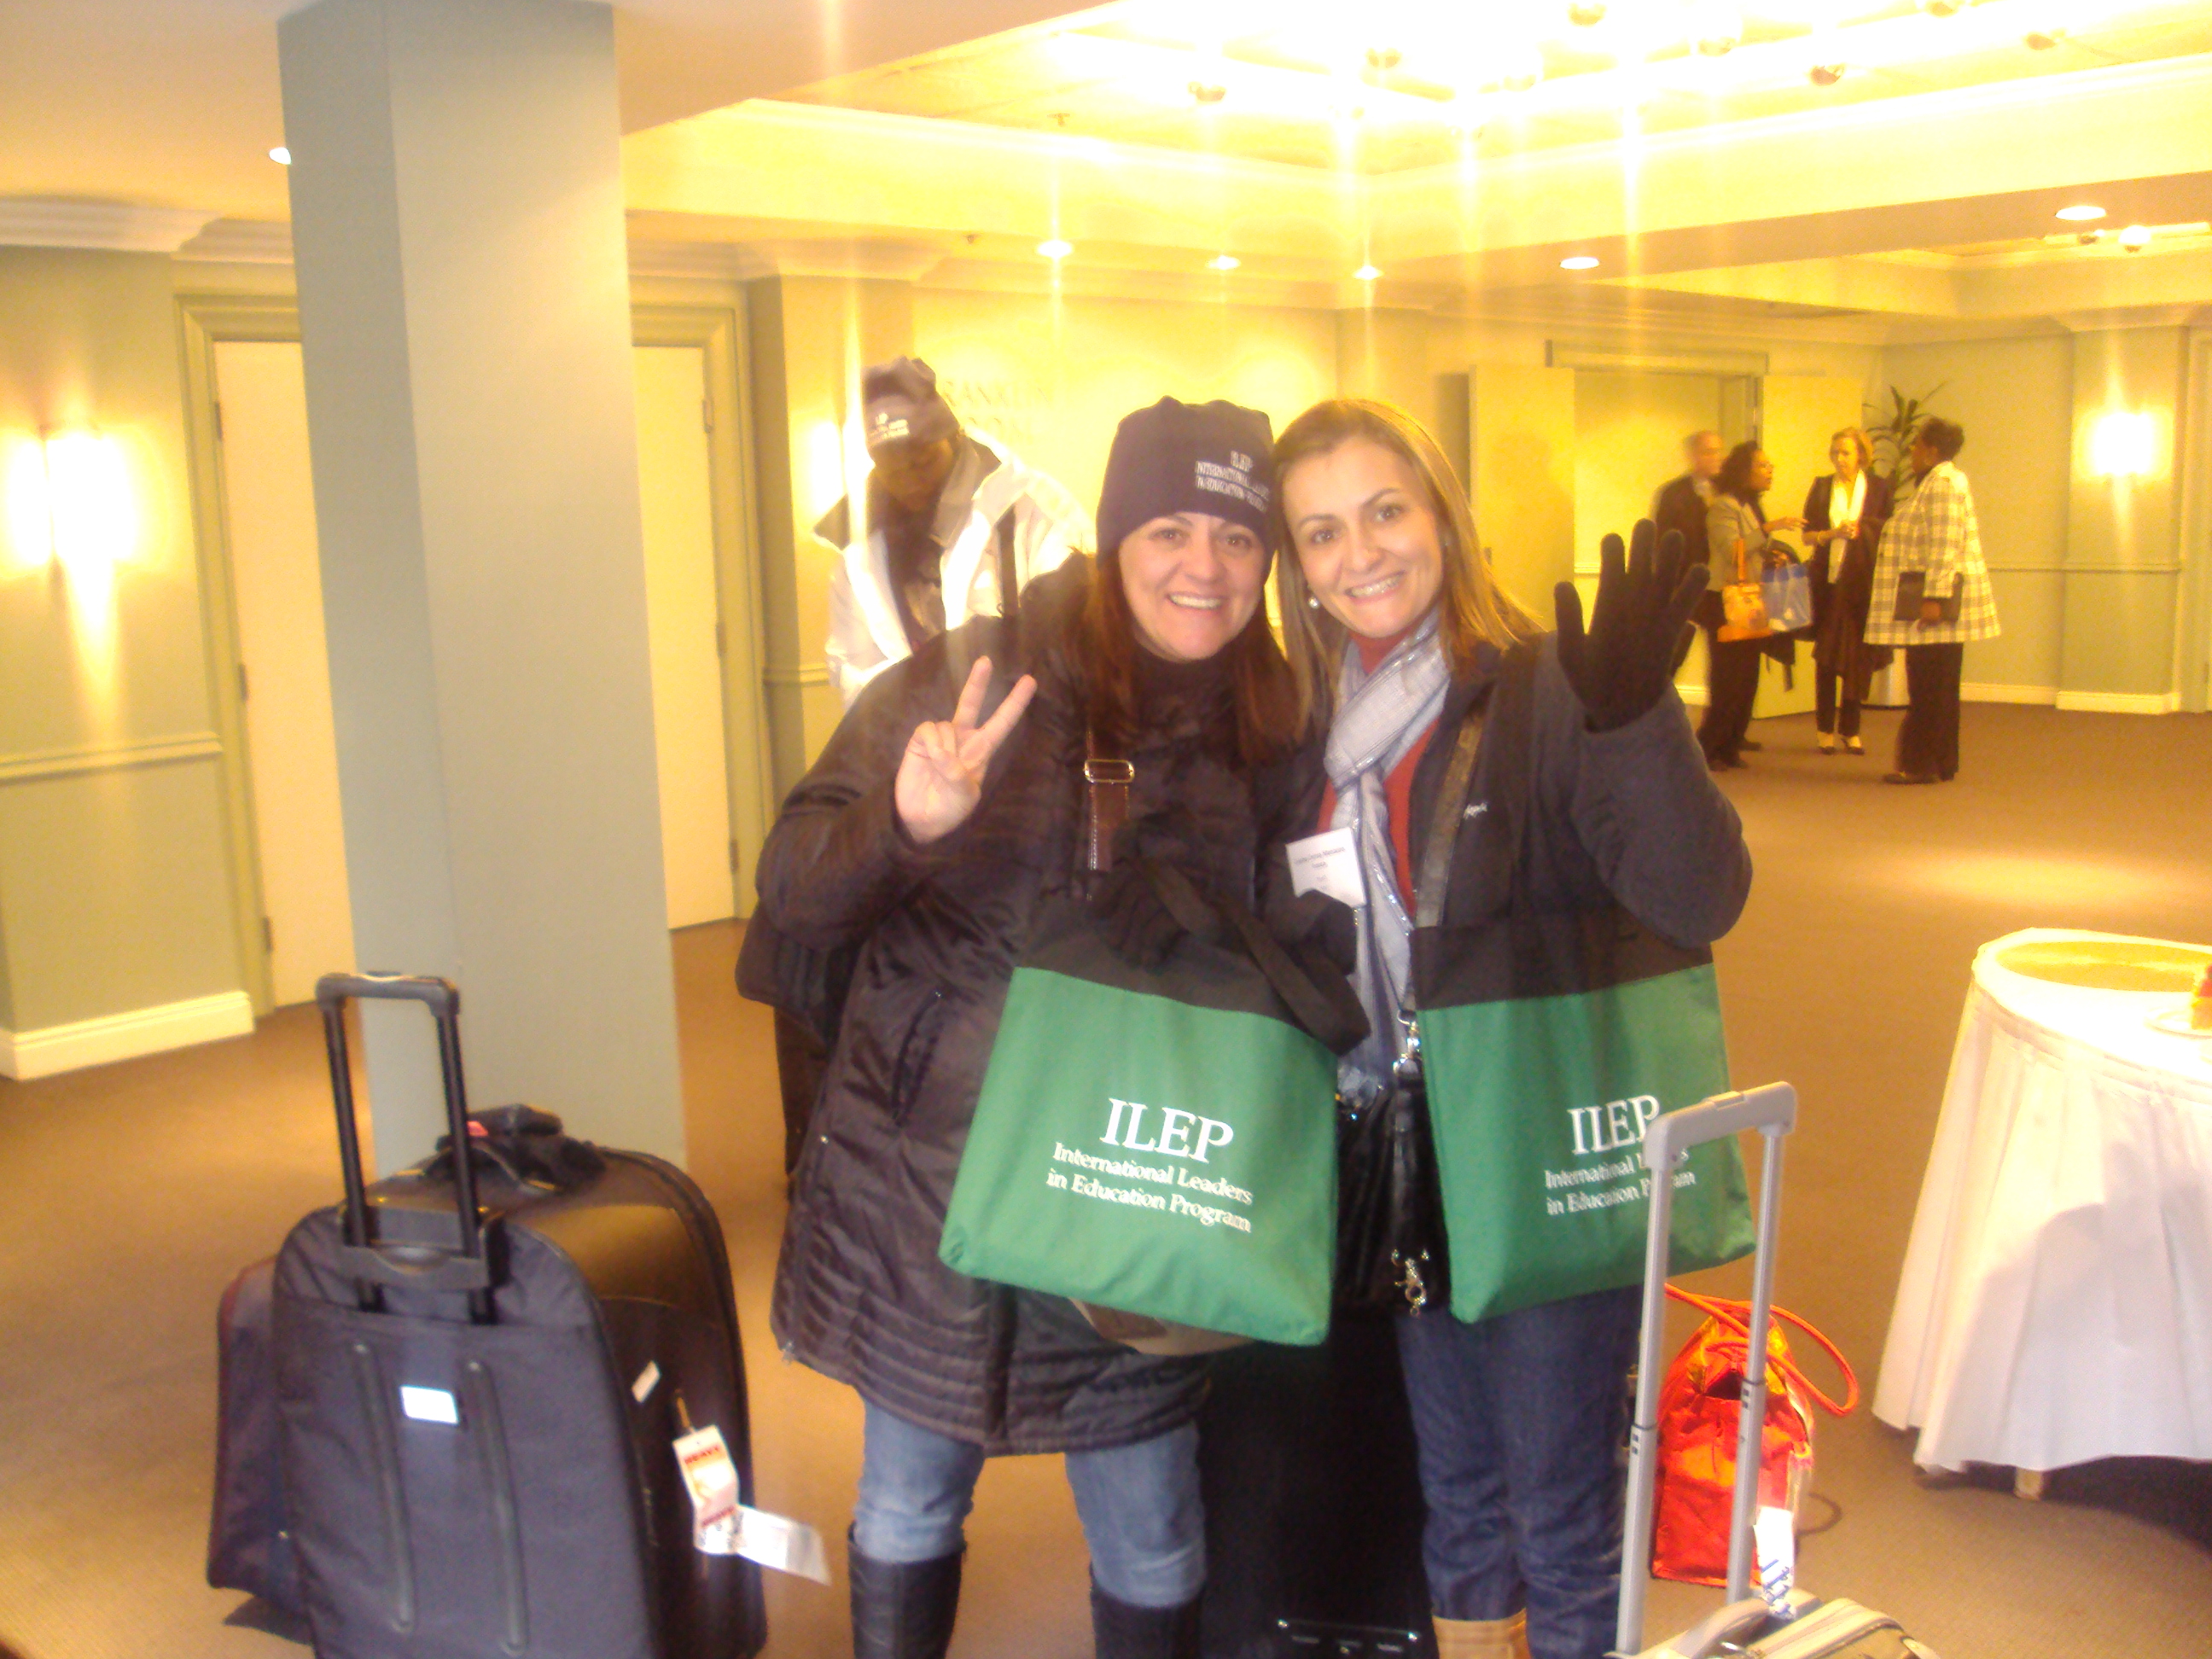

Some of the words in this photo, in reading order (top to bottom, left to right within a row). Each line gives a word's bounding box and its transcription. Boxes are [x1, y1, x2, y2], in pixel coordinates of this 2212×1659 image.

[1099, 1097, 1234, 1164] ILEP
[1566, 1094, 1660, 1155] ILEP
[1046, 1167, 1068, 1190] in
[1071, 1173, 1167, 1211] Education
[1169, 1193, 1252, 1233] Program
[1052, 1141, 1174, 1185] International
[1178, 1167, 1254, 1206] Leaders
[1546, 1196, 1565, 1215] in
